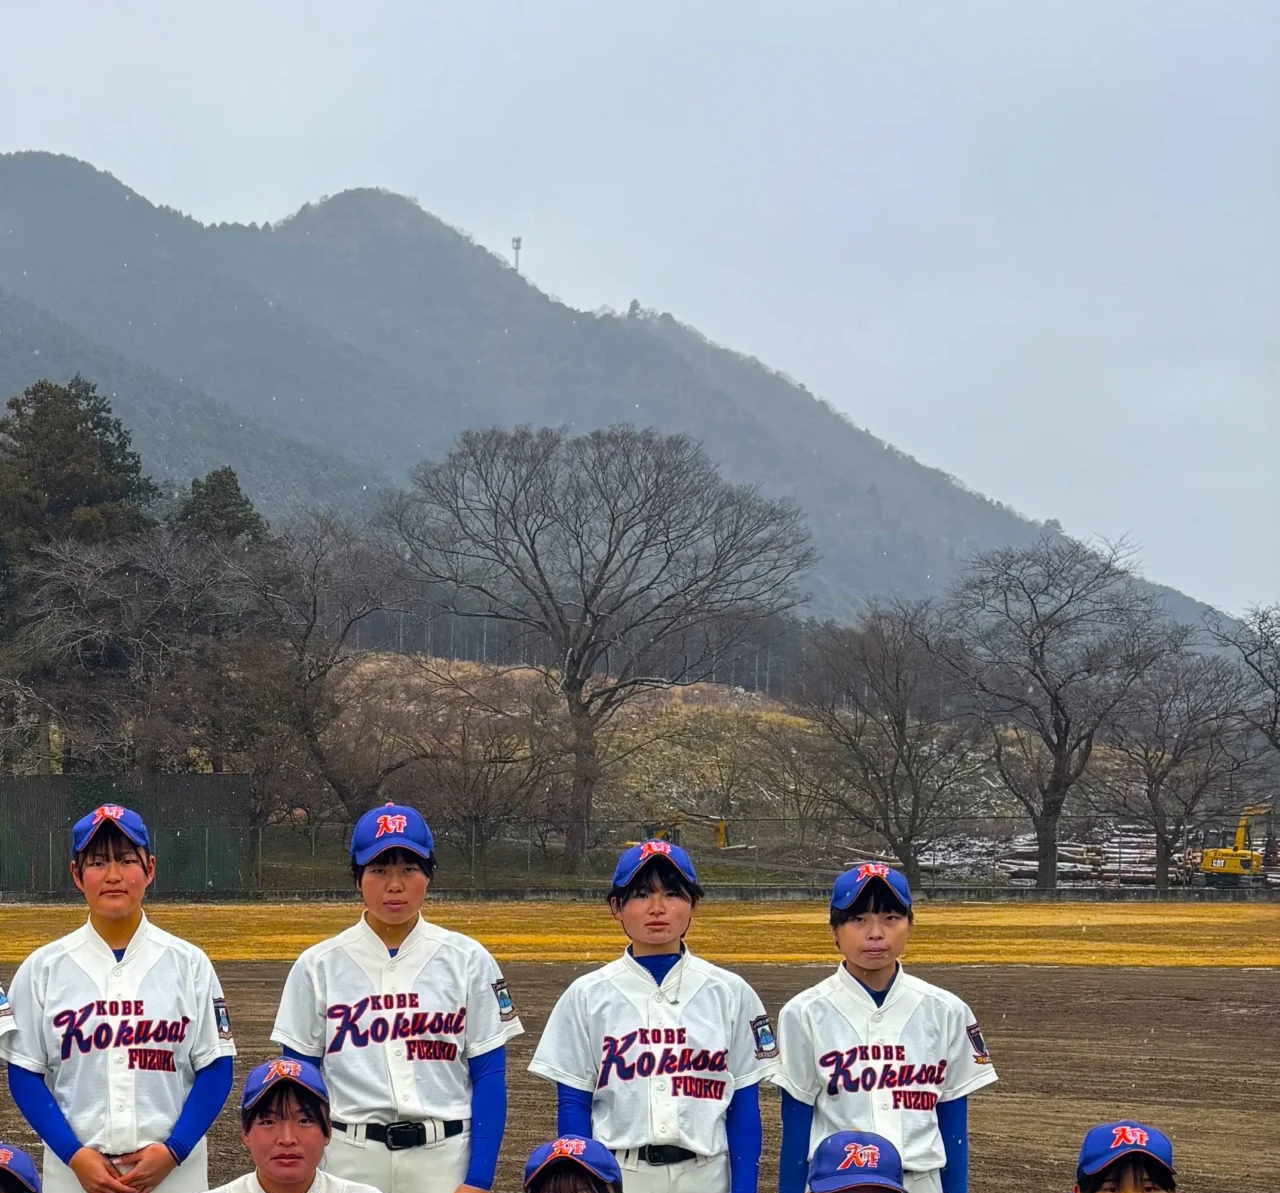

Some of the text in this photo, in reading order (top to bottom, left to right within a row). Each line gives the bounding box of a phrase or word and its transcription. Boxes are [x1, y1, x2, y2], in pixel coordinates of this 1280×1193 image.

[96, 1000, 144, 1016] KOBE
[370, 993, 419, 1010] KOBE
[53, 1002, 190, 1062] Kokusai
[327, 997, 466, 1054] Kokusai
[638, 1028, 686, 1044] KOBE
[597, 1031, 728, 1091] Kokusa
[858, 1045, 905, 1061] KOBE
